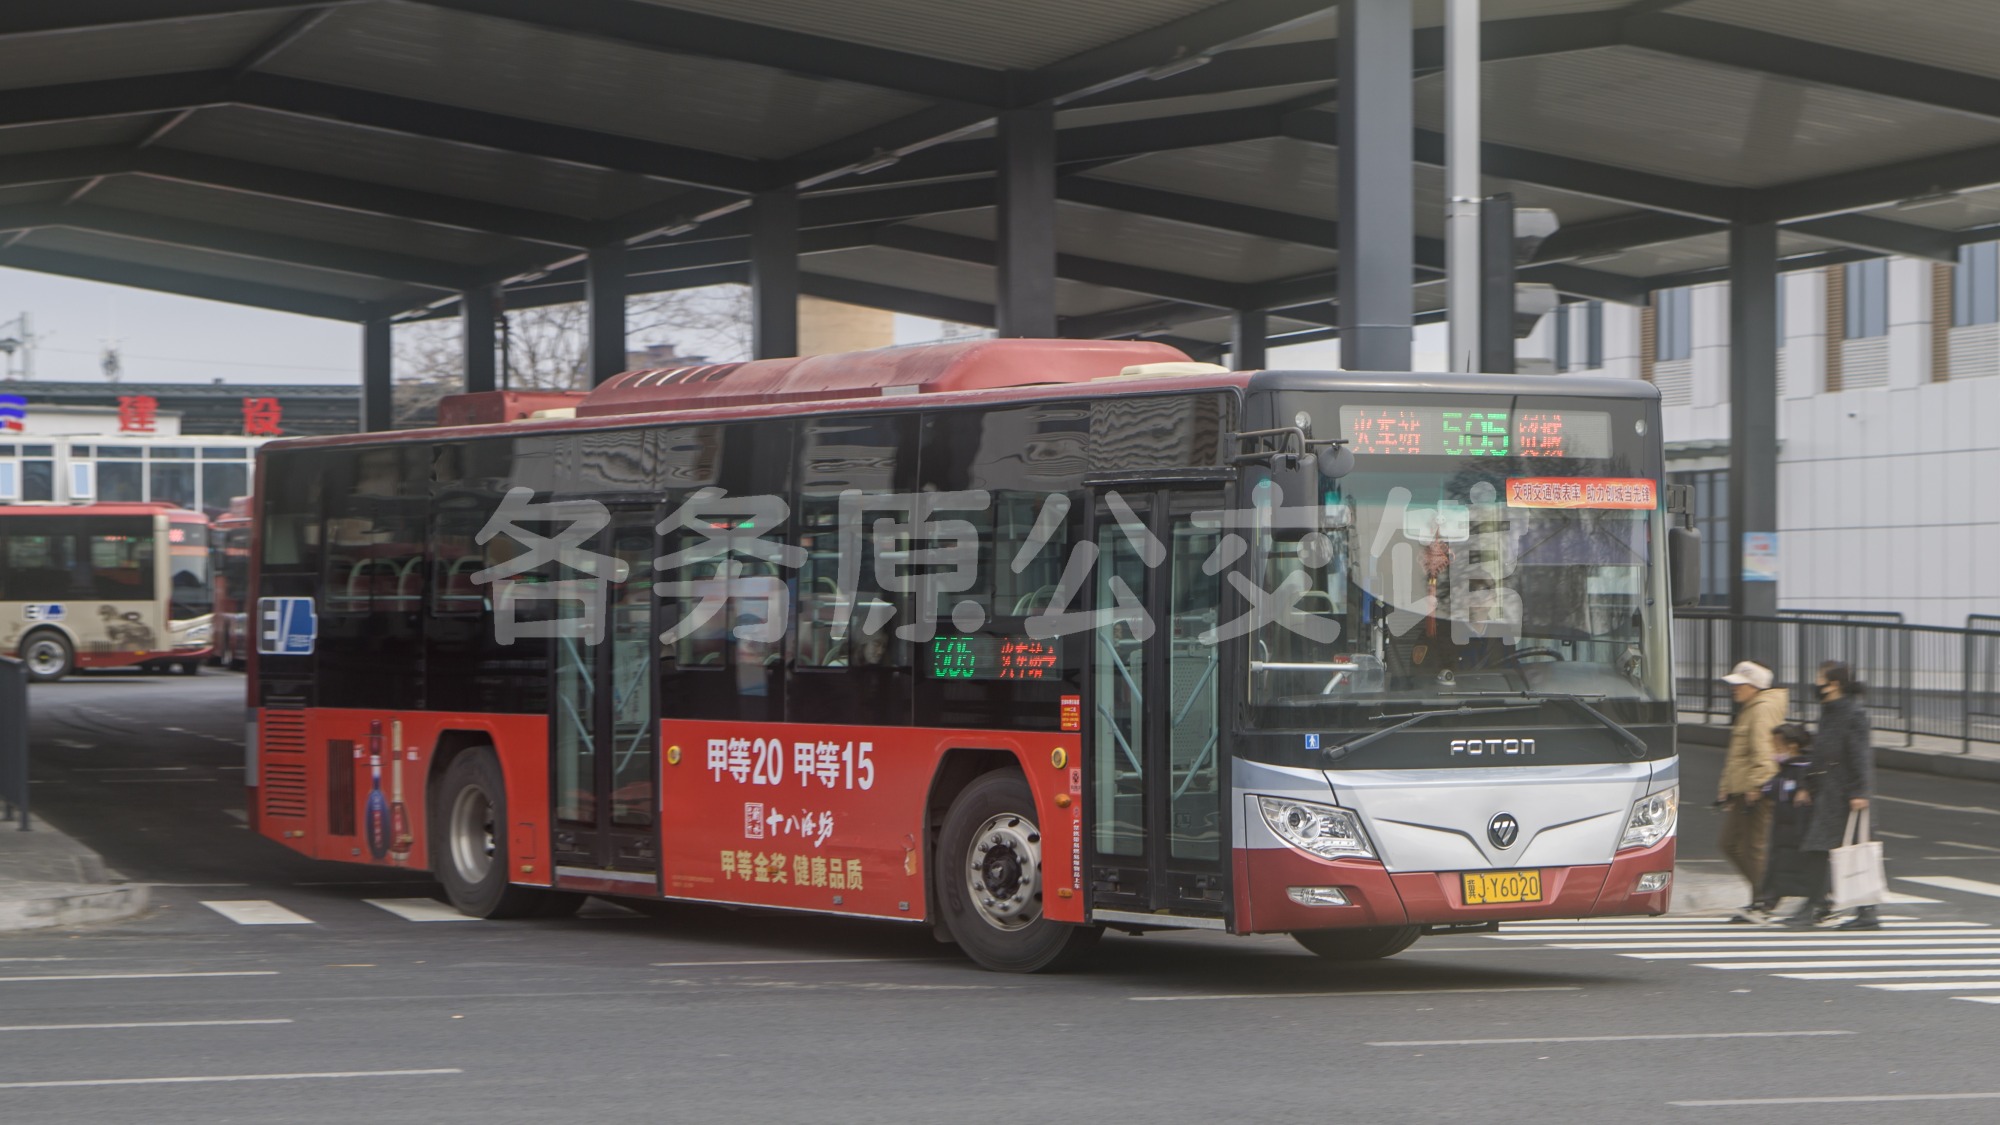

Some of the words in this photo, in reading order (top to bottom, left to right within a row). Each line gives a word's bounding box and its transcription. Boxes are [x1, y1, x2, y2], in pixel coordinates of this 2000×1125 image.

[1353, 411, 1421, 454] 火车站
[1443, 412, 1509, 456] 505
[1513, 483, 1581, 501] 文明交通做表率
[1586, 484, 1651, 502] 助力创城当先锋
[707, 737, 784, 785] 甲等20
[794, 741, 875, 790] 甲等15
[1450, 738, 1536, 756] FOTON
[720, 850, 787, 884] 甲等金奖
[793, 855, 863, 891] 健康品质
